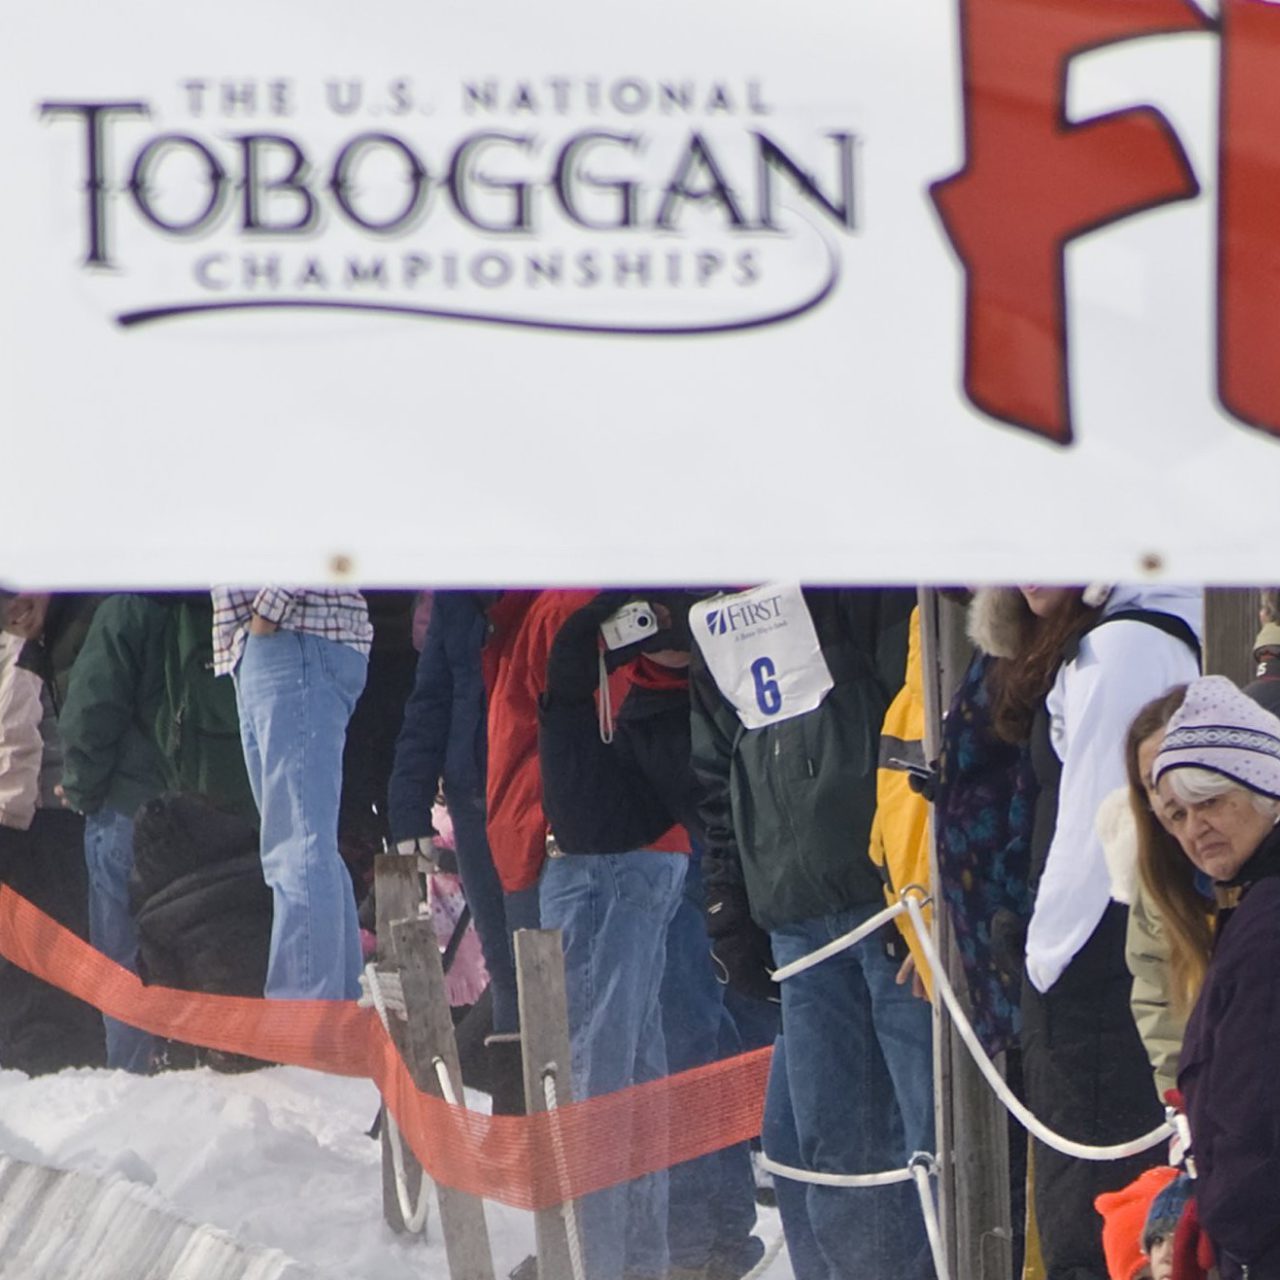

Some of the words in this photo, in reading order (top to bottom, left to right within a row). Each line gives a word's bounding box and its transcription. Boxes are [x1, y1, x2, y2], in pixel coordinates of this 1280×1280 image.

[184, 79, 288, 115] THE
[326, 79, 436, 115] U.S.
[463, 77, 769, 115] NATIONAL
[38, 101, 861, 268] TOBOGGAN
[194, 250, 759, 290] CHAMPIONSHIPS
[727, 595, 782, 631] FIRST
[751, 656, 781, 715] 6
